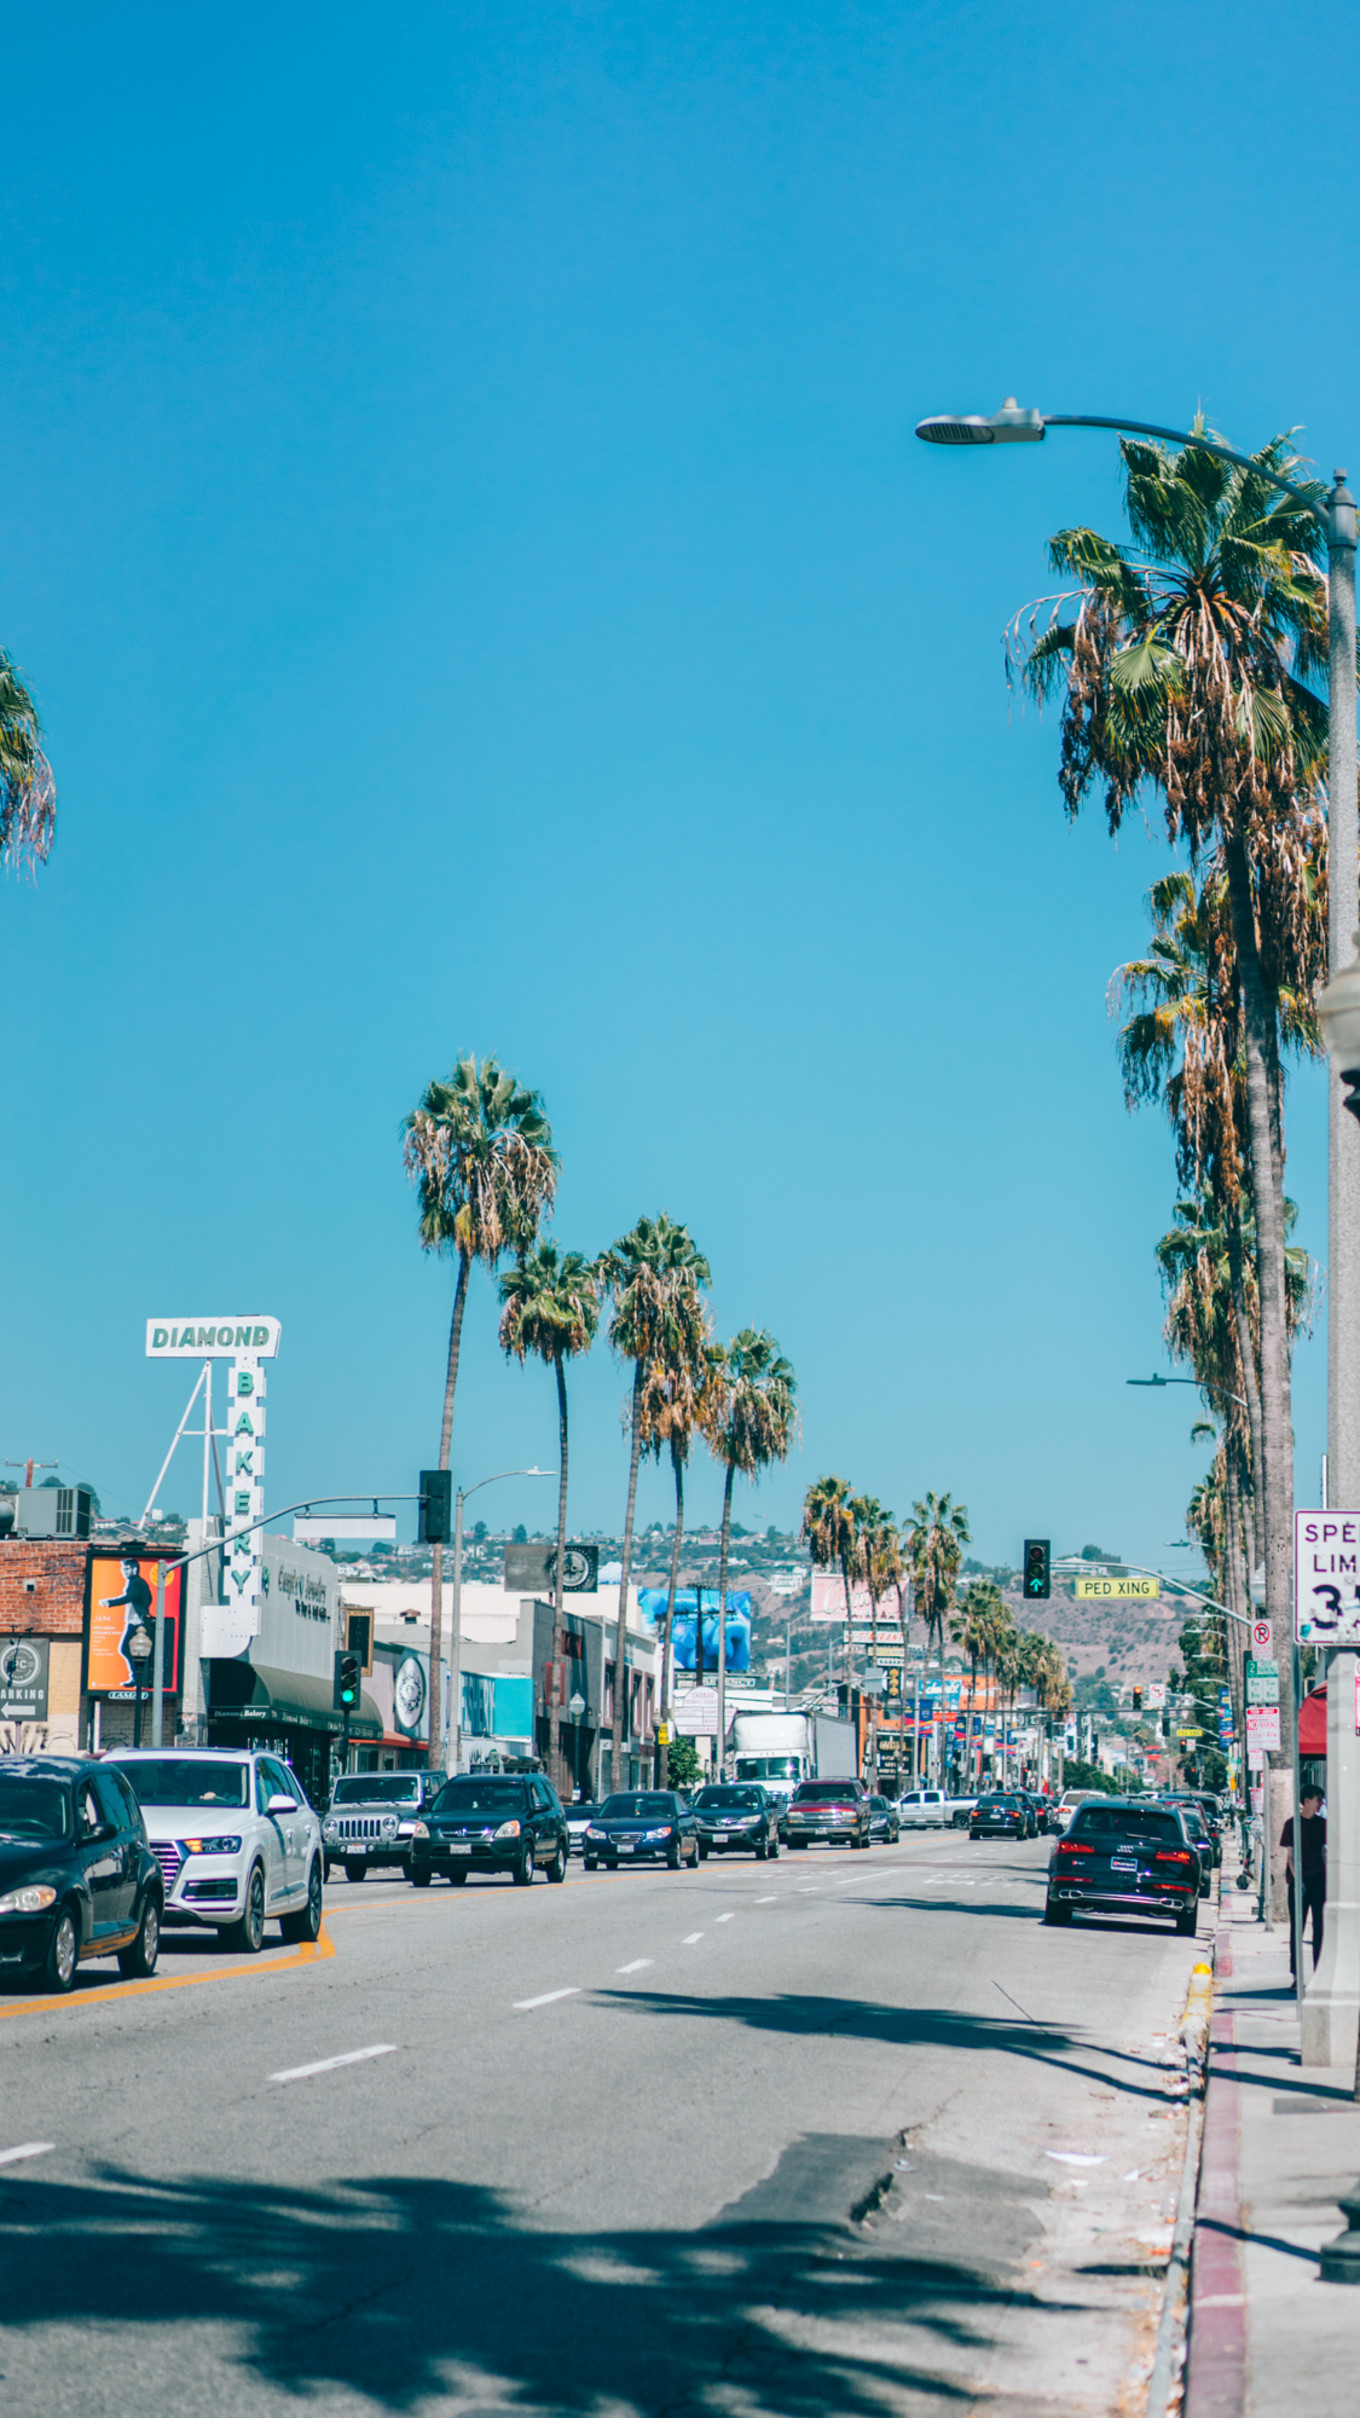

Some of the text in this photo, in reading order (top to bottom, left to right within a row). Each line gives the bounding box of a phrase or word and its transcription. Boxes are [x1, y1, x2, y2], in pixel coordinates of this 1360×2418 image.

[152, 1326, 270, 1348] DIAMOND
[230, 1371, 255, 1593] BAKERY
[1084, 1580, 1150, 1595] PED XING
[1249, 1662, 1257, 1673] 2
[0, 1688, 45, 1700] ARKING
[243, 1710, 267, 1719] Bakery
